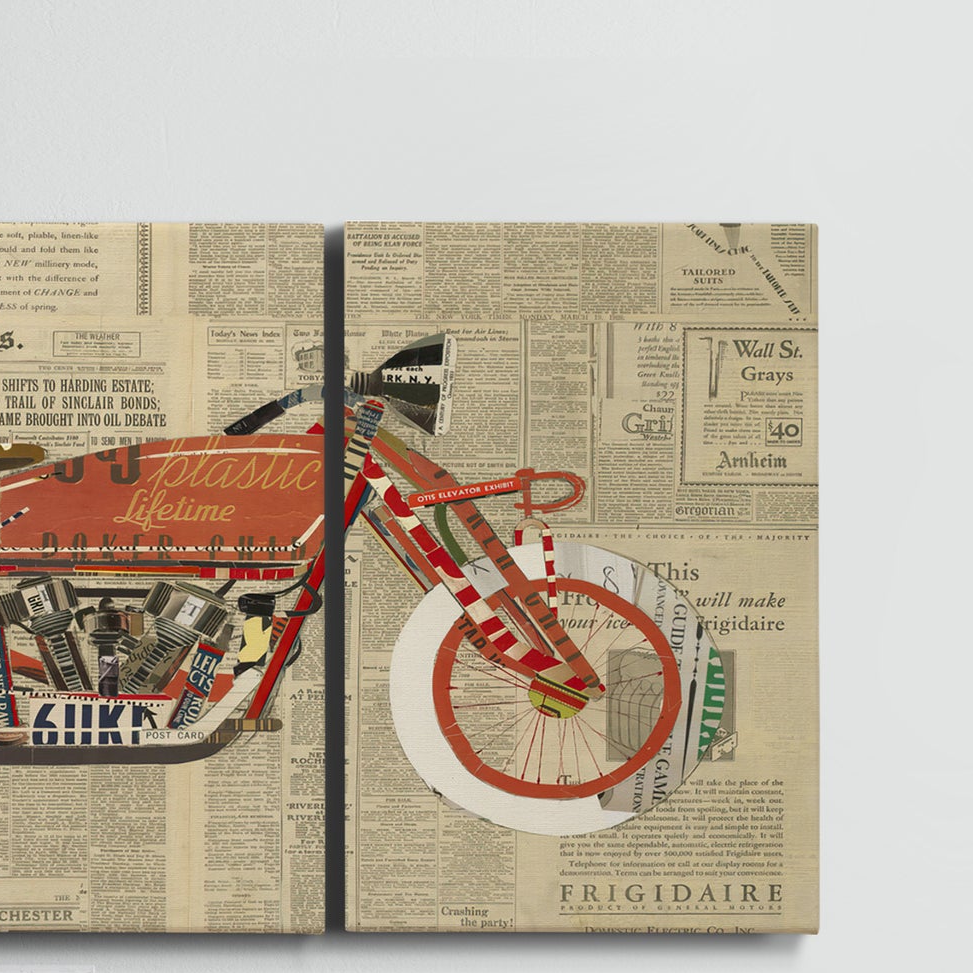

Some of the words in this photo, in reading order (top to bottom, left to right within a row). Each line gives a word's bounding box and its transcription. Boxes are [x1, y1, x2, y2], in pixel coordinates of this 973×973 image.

[28, 232, 57, 241] pliable,
[31, 304, 58, 312] spring.
[733, 340, 774, 358] Wall
[779, 340, 803, 358] St.
[741, 366, 794, 385] Grays
[2, 379, 39, 392] SHIFTS
[43, 379, 55, 392] TO
[61, 379, 106, 392] HARDING
[112, 379, 154, 394] ESTATE;
[5, 396, 36, 409] TRAIL
[42, 396, 56, 409] OF
[62, 396, 113, 409] SINCLAIR
[121, 397, 160, 412] BONDS;
[26, 413, 73, 426] BROUGHT
[78, 413, 100, 426] INTO
[104, 413, 121, 426] OIL
[125, 414, 166, 427] DEBATE
[717, 451, 787, 469] Arnheim
[417, 493, 436, 503] OTIS
[438, 487, 481, 500] ELEVATOR
[484, 481, 513, 491] EXHIBIT
[113, 489, 235, 531] Lifetime
[676, 506, 735, 516] Gregorian
[647, 562, 699, 581] This
[696, 592, 730, 608] will
[739, 592, 785, 608] make
[560, 841, 575, 849] give
[739, 841, 783, 850] refrigeration
[560, 884, 782, 902] FRIGIDAIRE
[441, 907, 489, 917] Crashing
[461, 918, 477, 928] the
[481, 918, 514, 928] party!
